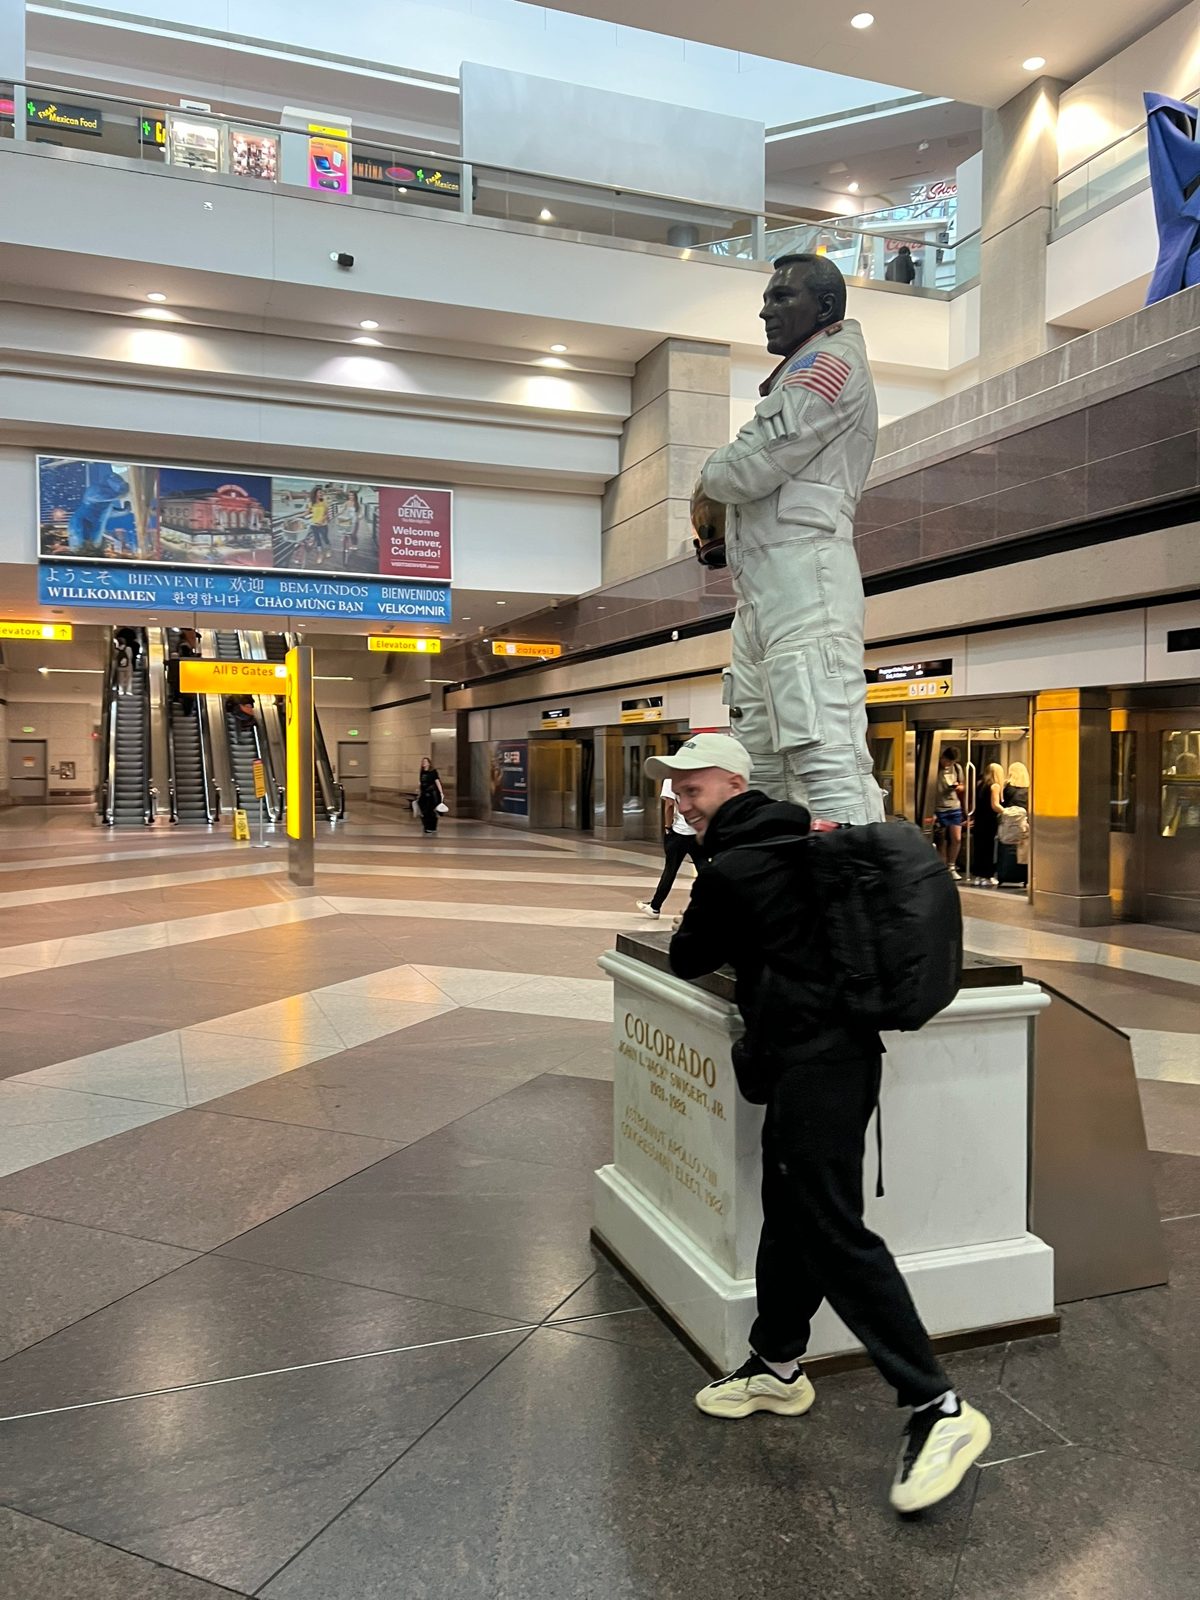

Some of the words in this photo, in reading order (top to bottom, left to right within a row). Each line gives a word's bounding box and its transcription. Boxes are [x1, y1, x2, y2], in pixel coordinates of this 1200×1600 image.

[48, 113, 79, 125] Mexican
[80, 117, 97, 129] Food
[398, 507, 434, 519] DENVER
[392, 525, 440, 537] Welcome
[391, 537, 402, 545] to
[404, 537, 442, 549] Denver,
[391, 546, 441, 558] Colorado!
[46, 568, 112, 586] ようこそ
[128, 573, 214, 589] BIENVENUE
[228, 577, 264, 594] 欢迎
[280, 581, 368, 597] BEM-VINDOS
[47, 586, 156, 602] WILLKOMMEN
[172, 591, 241, 607] 환영합니다
[381, 587, 446, 602] BIENVENIDOS
[378, 602, 446, 616] VELKOMNIR
[376, 640, 416, 649] Elevators
[213, 665, 228, 675] All
[231, 666, 238, 675] B
[241, 666, 274, 676] Gates
[624, 1012, 717, 1090] COLORADO
